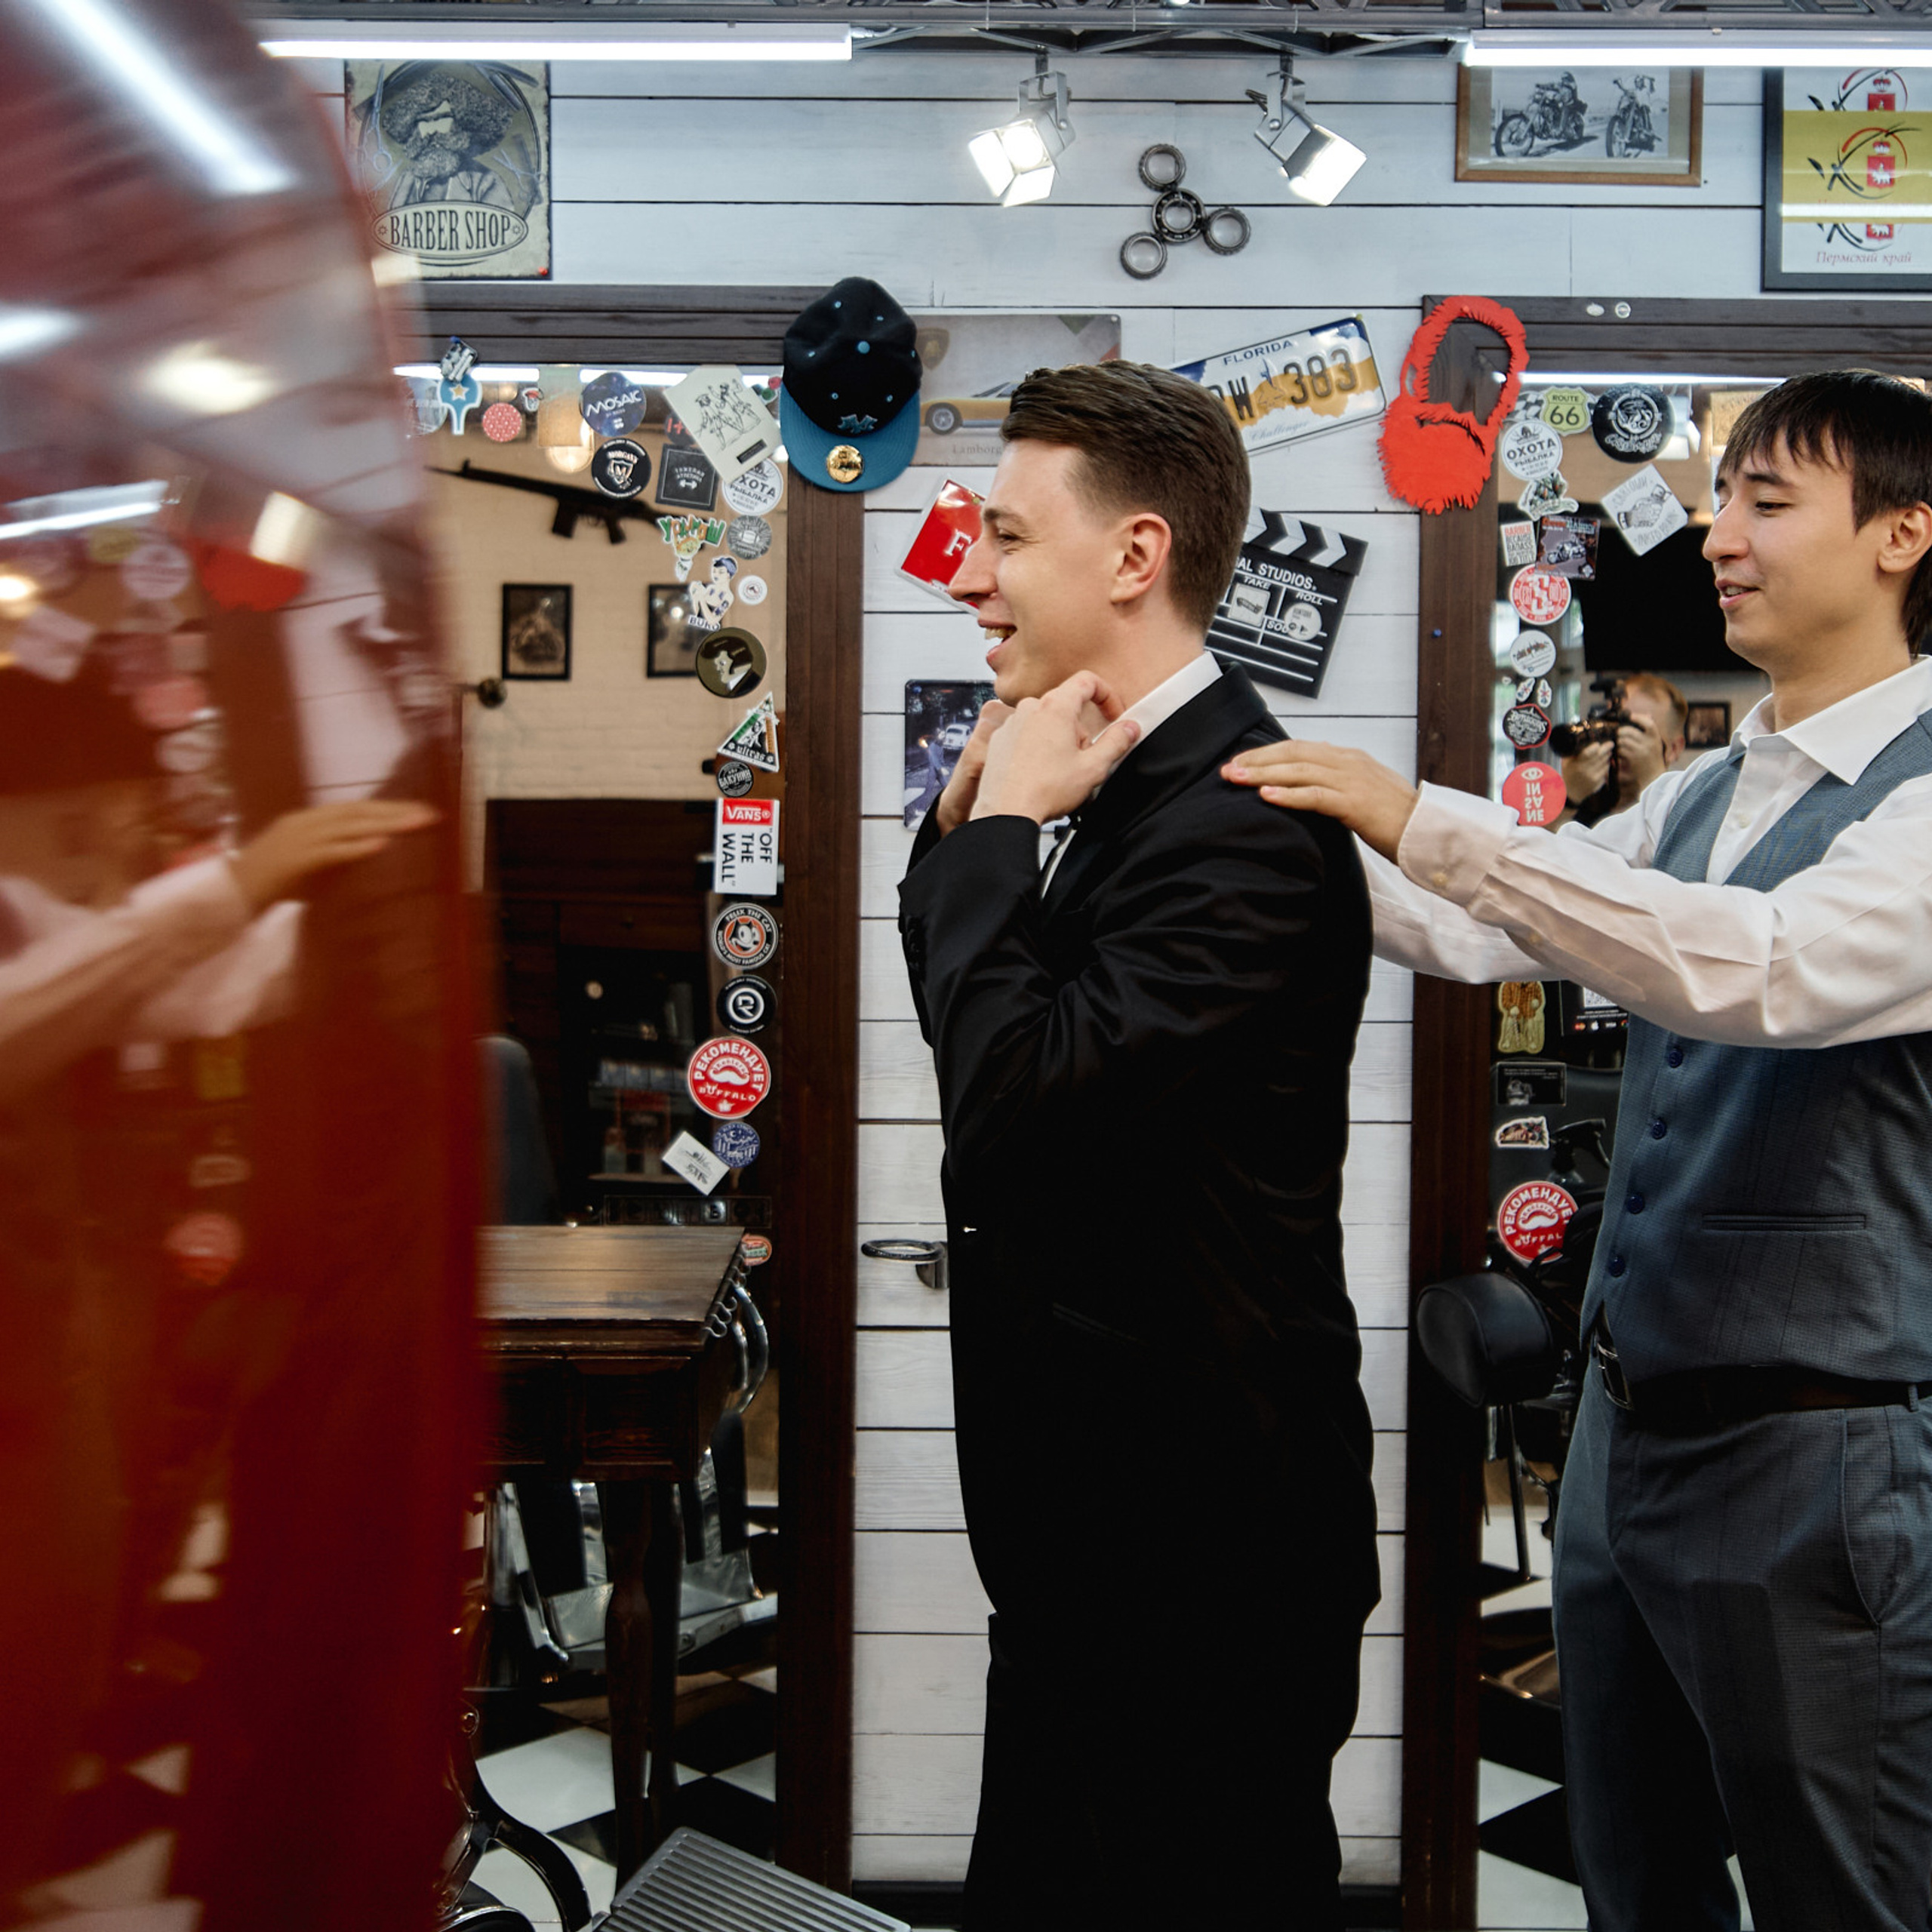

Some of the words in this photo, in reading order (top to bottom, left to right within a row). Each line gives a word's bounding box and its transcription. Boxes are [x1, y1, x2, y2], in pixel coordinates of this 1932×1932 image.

[389, 209, 460, 251] BARBER
[465, 211, 511, 250] SHOP
[1816, 251, 1878, 266] Пермский
[1883, 251, 1912, 266] край
[1223, 340, 1294, 366] FLORIDA
[1283, 348, 1358, 405] 383
[586, 389, 642, 417] MOSAIC
[1552, 394, 1579, 402] ROUTE
[1549, 405, 1580, 426] 66
[952, 444, 1003, 456] Lamborg
[1506, 438, 1556, 460] ОХОТА
[730, 485, 768, 504] РЫБАЛКА
[735, 474, 777, 498] ХОТА
[1243, 576, 1271, 590] TAKE
[1258, 563, 1313, 589] STUDIOS
[1296, 592, 1323, 606] ROLL
[736, 744, 766, 761] ultras
[741, 832, 755, 864] THE
[725, 908, 746, 922] FELIX
[747, 909, 763, 919] THE
[761, 918, 773, 933] CAT
[741, 952, 764, 965] FAMOUS
[694, 1042, 765, 1092] РЕКОМЕНДУЕТ
[698, 1082, 757, 1103] BUFFALO
[1503, 1186, 1574, 1236] РЕКОМЕНДУЕ
[1514, 1232, 1563, 1247] BUFFAL
